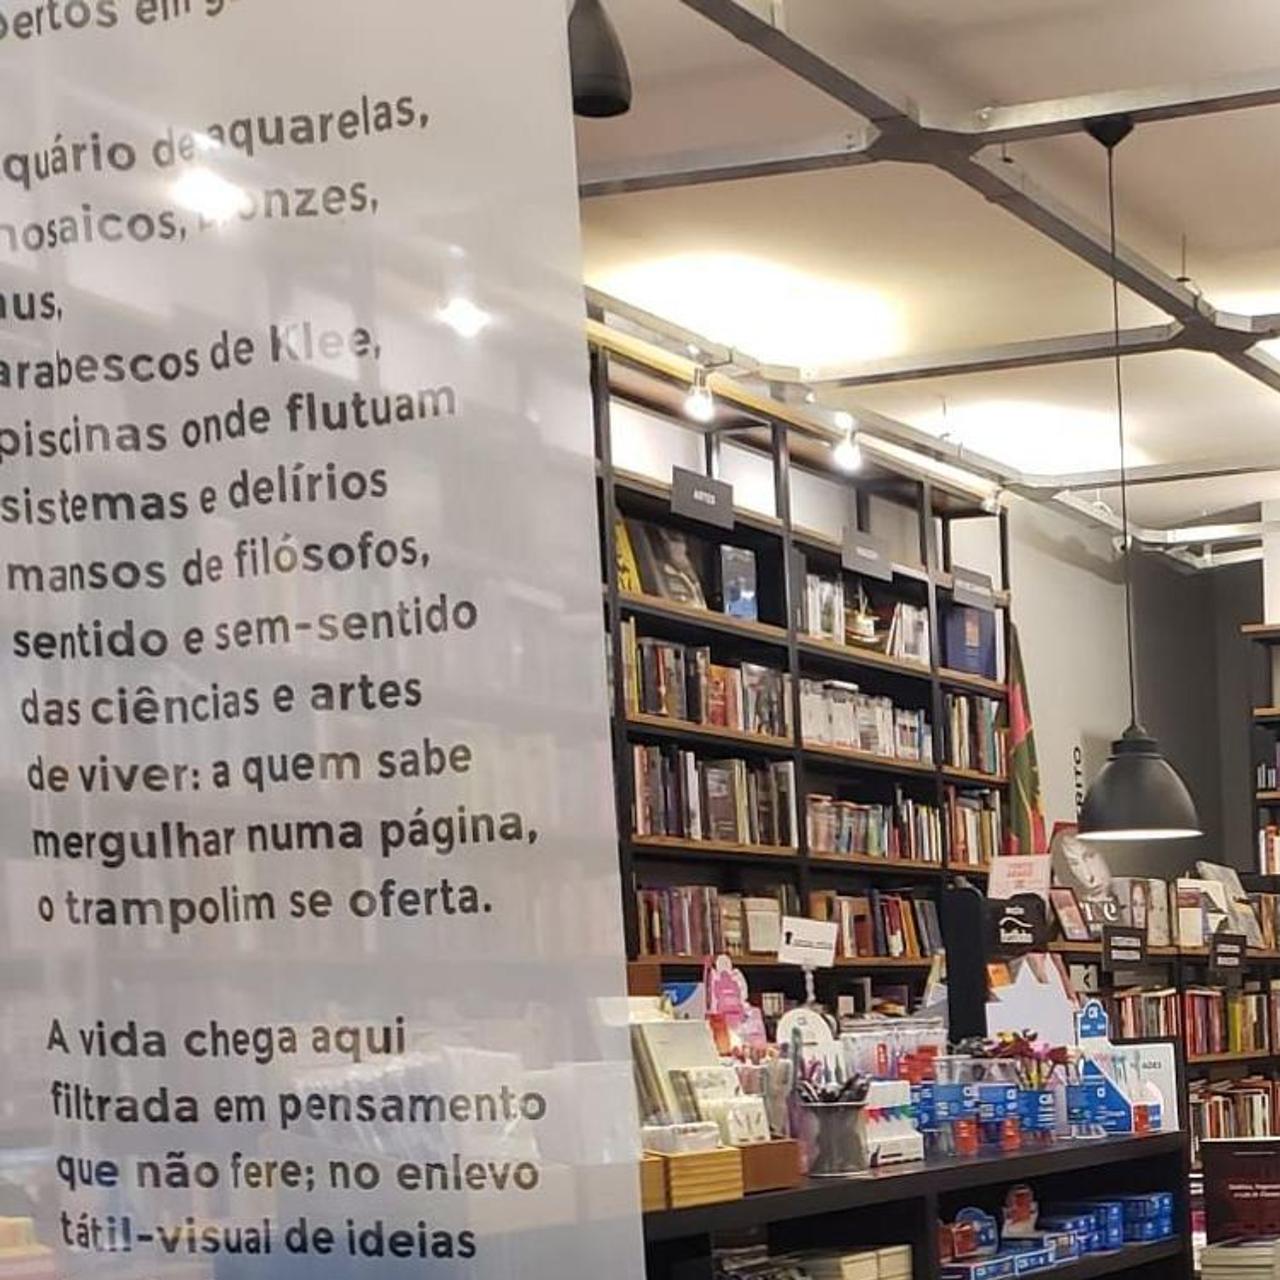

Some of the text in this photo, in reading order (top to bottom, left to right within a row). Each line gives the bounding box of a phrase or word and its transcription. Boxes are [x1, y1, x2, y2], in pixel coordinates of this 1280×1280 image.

[153, 125, 196, 168] de
[206, 95, 430, 157] aquarelas,
[199, 181, 378, 232] onzes,
[0, 322, 381, 389] arabescos de Klee,
[0, 383, 455, 461] piscinas onde flutuam
[0, 463, 388, 525] sistemas e delírios
[7, 532, 430, 592] mansos de filósofos,
[12, 594, 478, 659] sentido e sem-sentido
[21, 674, 422, 725] das ciências e artes
[27, 739, 472, 791] de viver: a quem sabe
[33, 808, 539, 868] mergulhar numa página,
[39, 878, 493, 933] o trampolim se oferta.
[47, 1018, 406, 1064] A vida chega aqui
[51, 1081, 547, 1129] filtrada em pensamento
[56, 1151, 539, 1192] que não fere; no enlevo
[60, 1210, 477, 1256] tátil-visual de ideias
